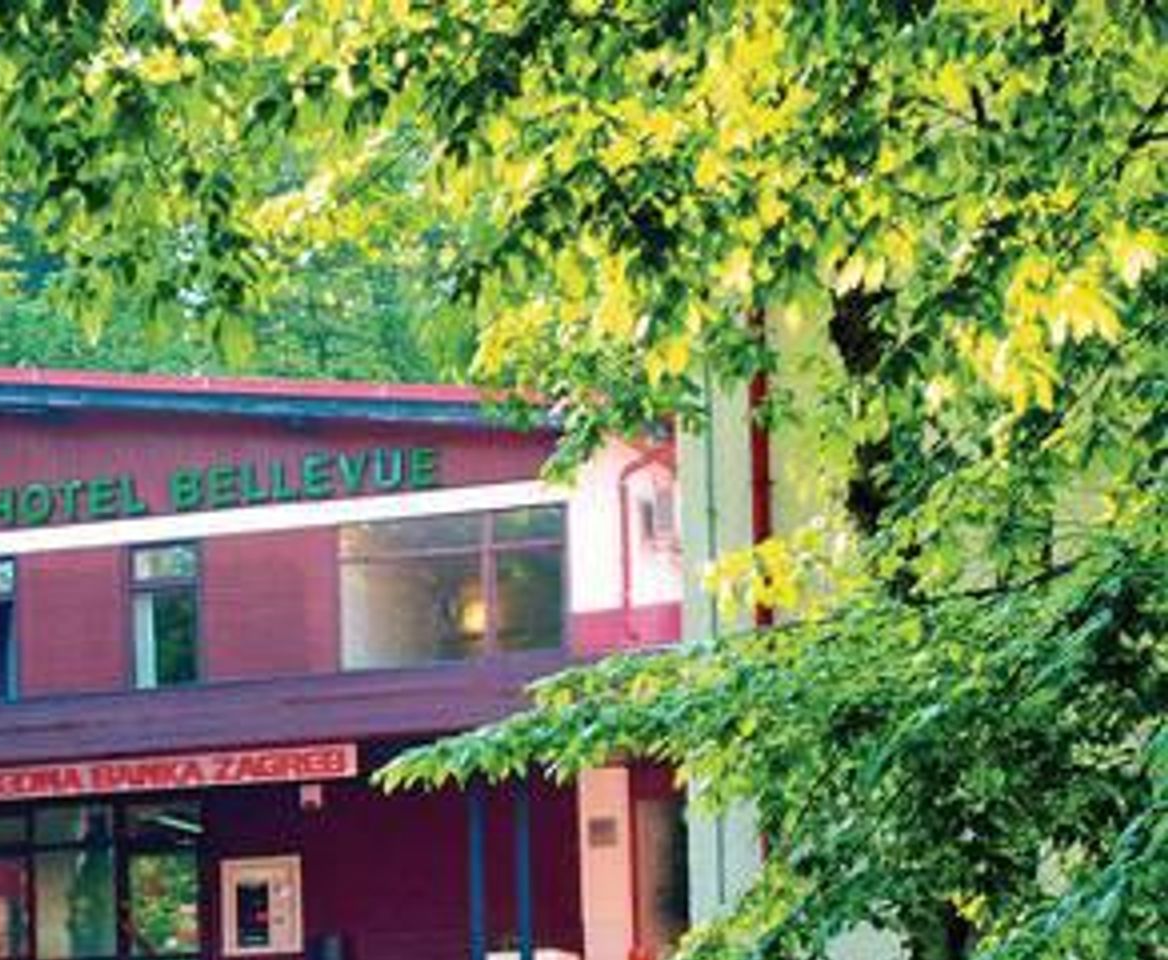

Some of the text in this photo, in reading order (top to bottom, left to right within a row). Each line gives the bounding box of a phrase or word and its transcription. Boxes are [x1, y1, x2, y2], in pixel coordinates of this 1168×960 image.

[169, 447, 441, 505] BELLEVUE
[91, 760, 203, 791] BANKA
[211, 749, 345, 783] ZAGREB
